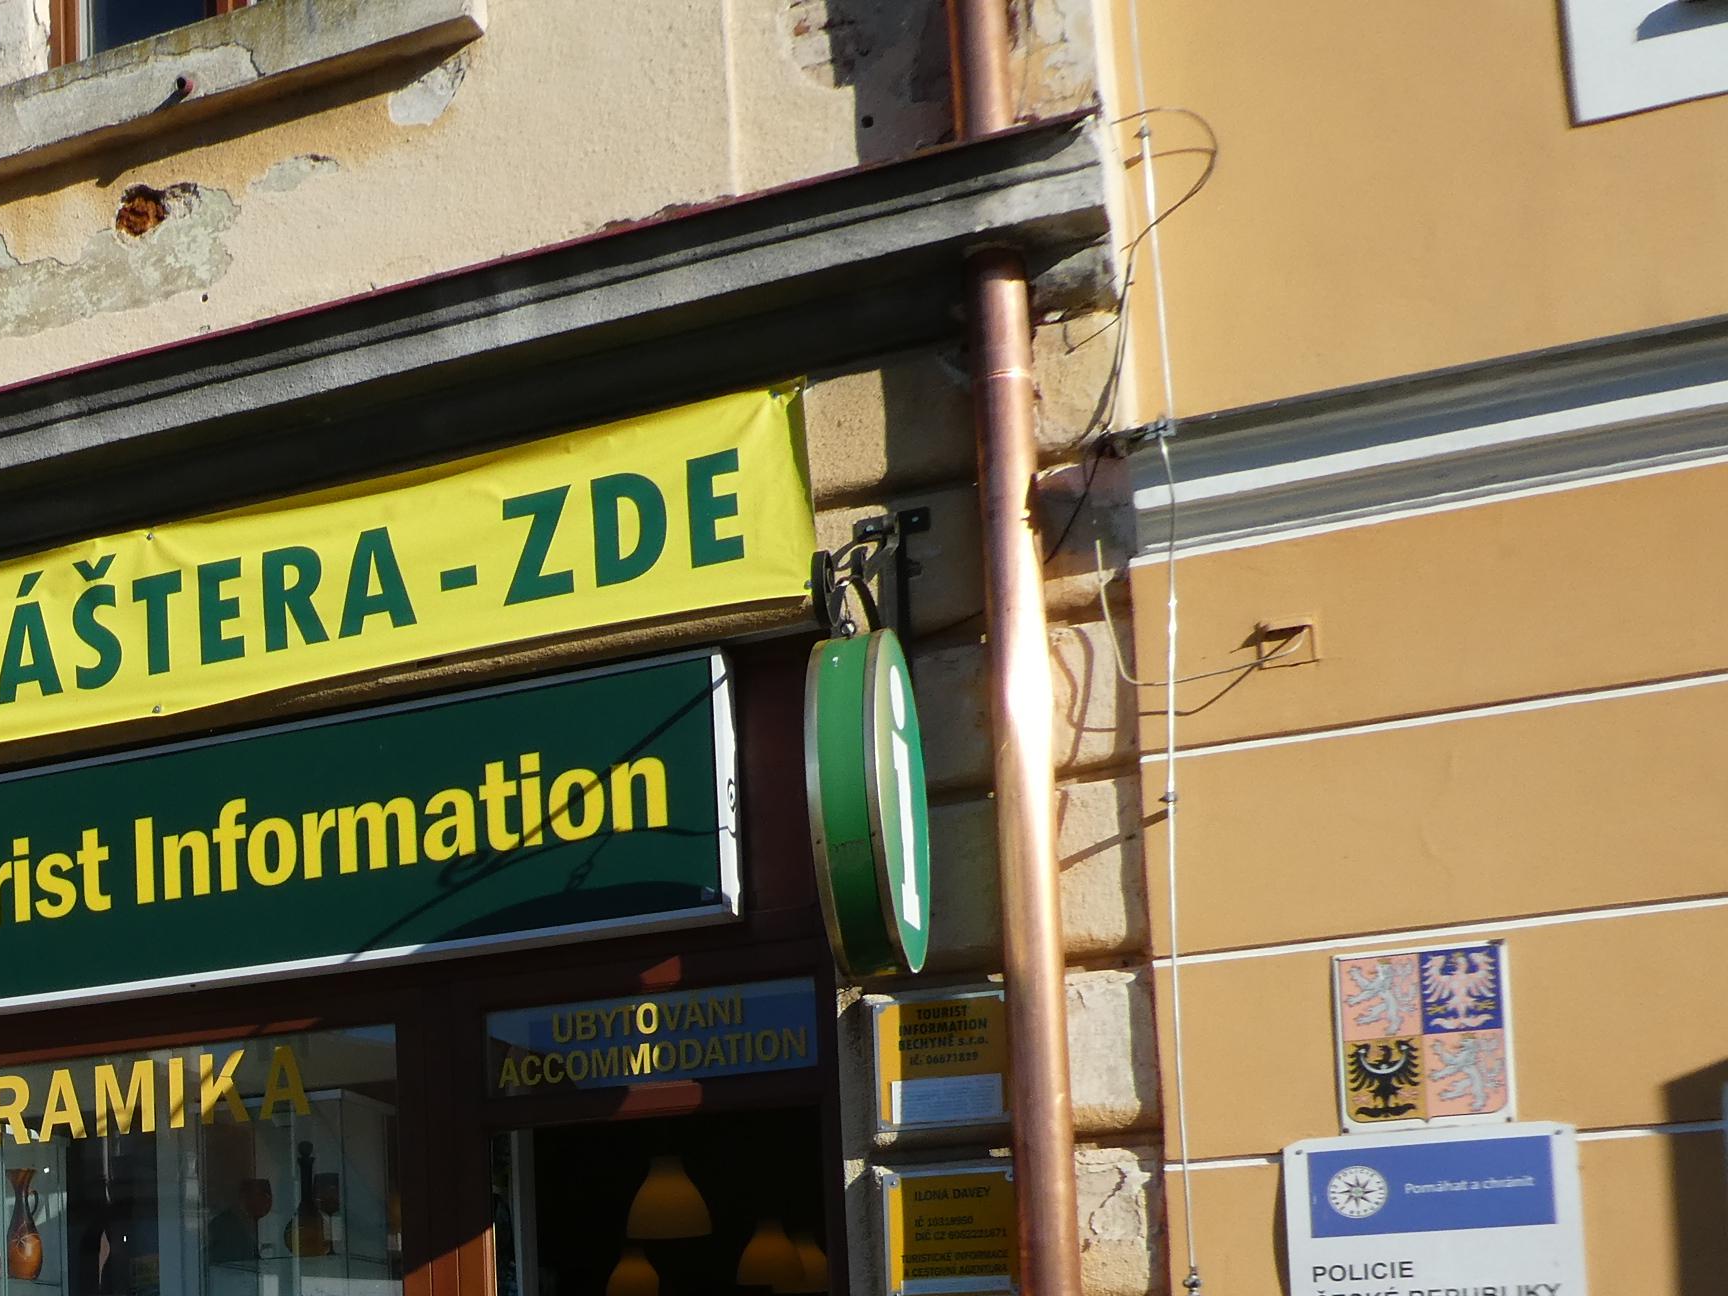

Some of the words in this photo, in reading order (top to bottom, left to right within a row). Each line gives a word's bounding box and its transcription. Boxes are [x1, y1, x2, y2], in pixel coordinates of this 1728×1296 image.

[502, 448, 745, 606] ZDE
[135, 751, 670, 905] Information
[916, 1005, 968, 1019] TOURIST
[899, 1018, 988, 1036] INFORMATION
[498, 1027, 808, 1089] ACCOMMODATION
[1404, 1179, 1469, 1195] Pomáhat
[1312, 1261, 1414, 1283] POLICIE
